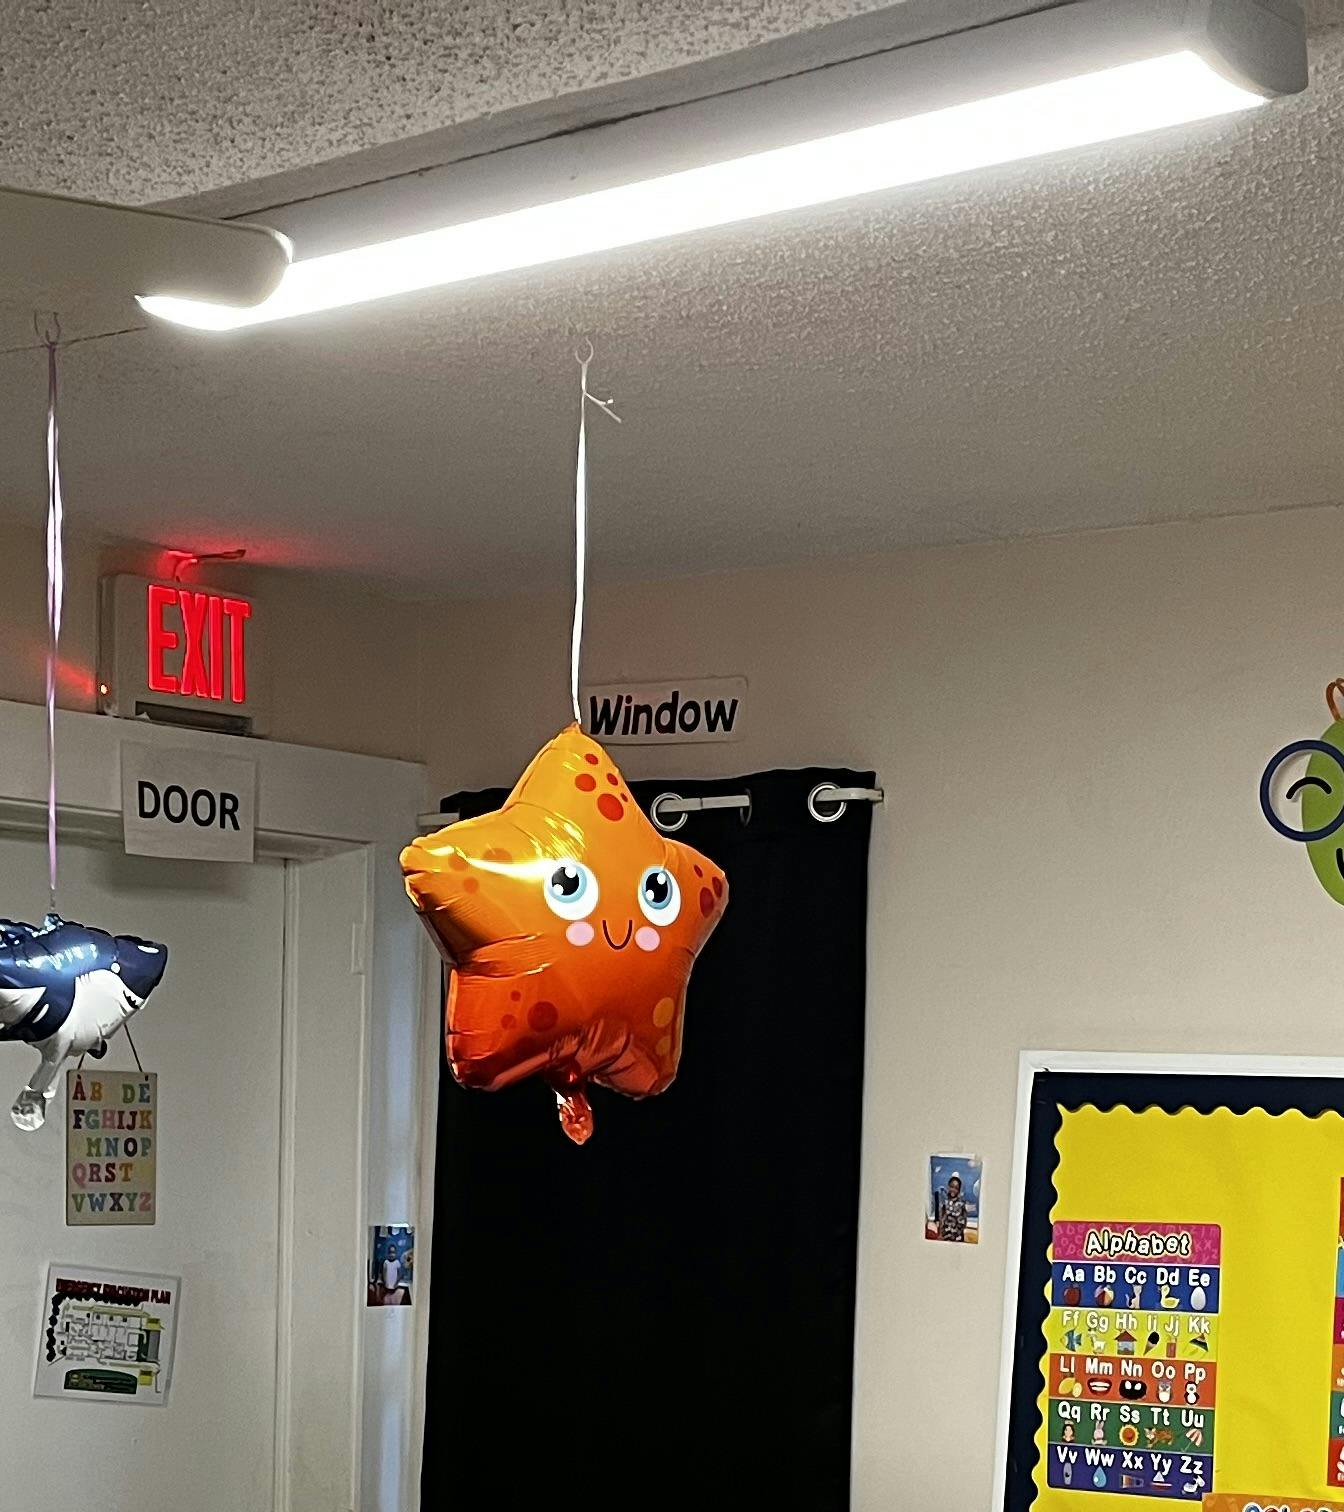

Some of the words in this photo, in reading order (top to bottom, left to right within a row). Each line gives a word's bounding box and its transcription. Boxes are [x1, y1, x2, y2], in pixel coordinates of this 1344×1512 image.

[148, 583, 252, 703] EXIT
[590, 690, 738, 736] Window
[137, 780, 240, 831] DOOR
[73, 1137, 151, 1157] MNOP
[72, 1163, 151, 1188] QRST
[1087, 1230, 1191, 1255] Alphabet
[1062, 1266, 1085, 1282] Aa
[1094, 1267, 1116, 1283] Bb
[1125, 1267, 1147, 1284] Cc
[1156, 1268, 1179, 1285] Dd
[1188, 1269, 1211, 1287] Ee
[1062, 1311, 1079, 1327] Ff
[1087, 1313, 1109, 1332] Gg
[1116, 1314, 1137, 1330] Hh
[1147, 1315, 1156, 1331] Ii
[1165, 1316, 1180, 1336] Jj
[1188, 1317, 1210, 1334] Kk
[1059, 1356, 1075, 1373] Ll
[1086, 1357, 1113, 1375] Mm
[1121, 1360, 1143, 1377] Nn
[1151, 1362, 1176, 1379] Oo
[1185, 1363, 1206, 1384] Pp
[1058, 1402, 1080, 1422] Qq
[1090, 1404, 1110, 1420] Rr
[1119, 1406, 1140, 1423] Ss
[1151, 1409, 1170, 1425] Tt
[1181, 1410, 1204, 1427] Uu
[1057, 1447, 1077, 1464] Vv
[1085, 1449, 1114, 1466] Ww
[1122, 1452, 1143, 1470] Xx
[1151, 1454, 1172, 1472] Yy
[1180, 1456, 1203, 1474] Zz
